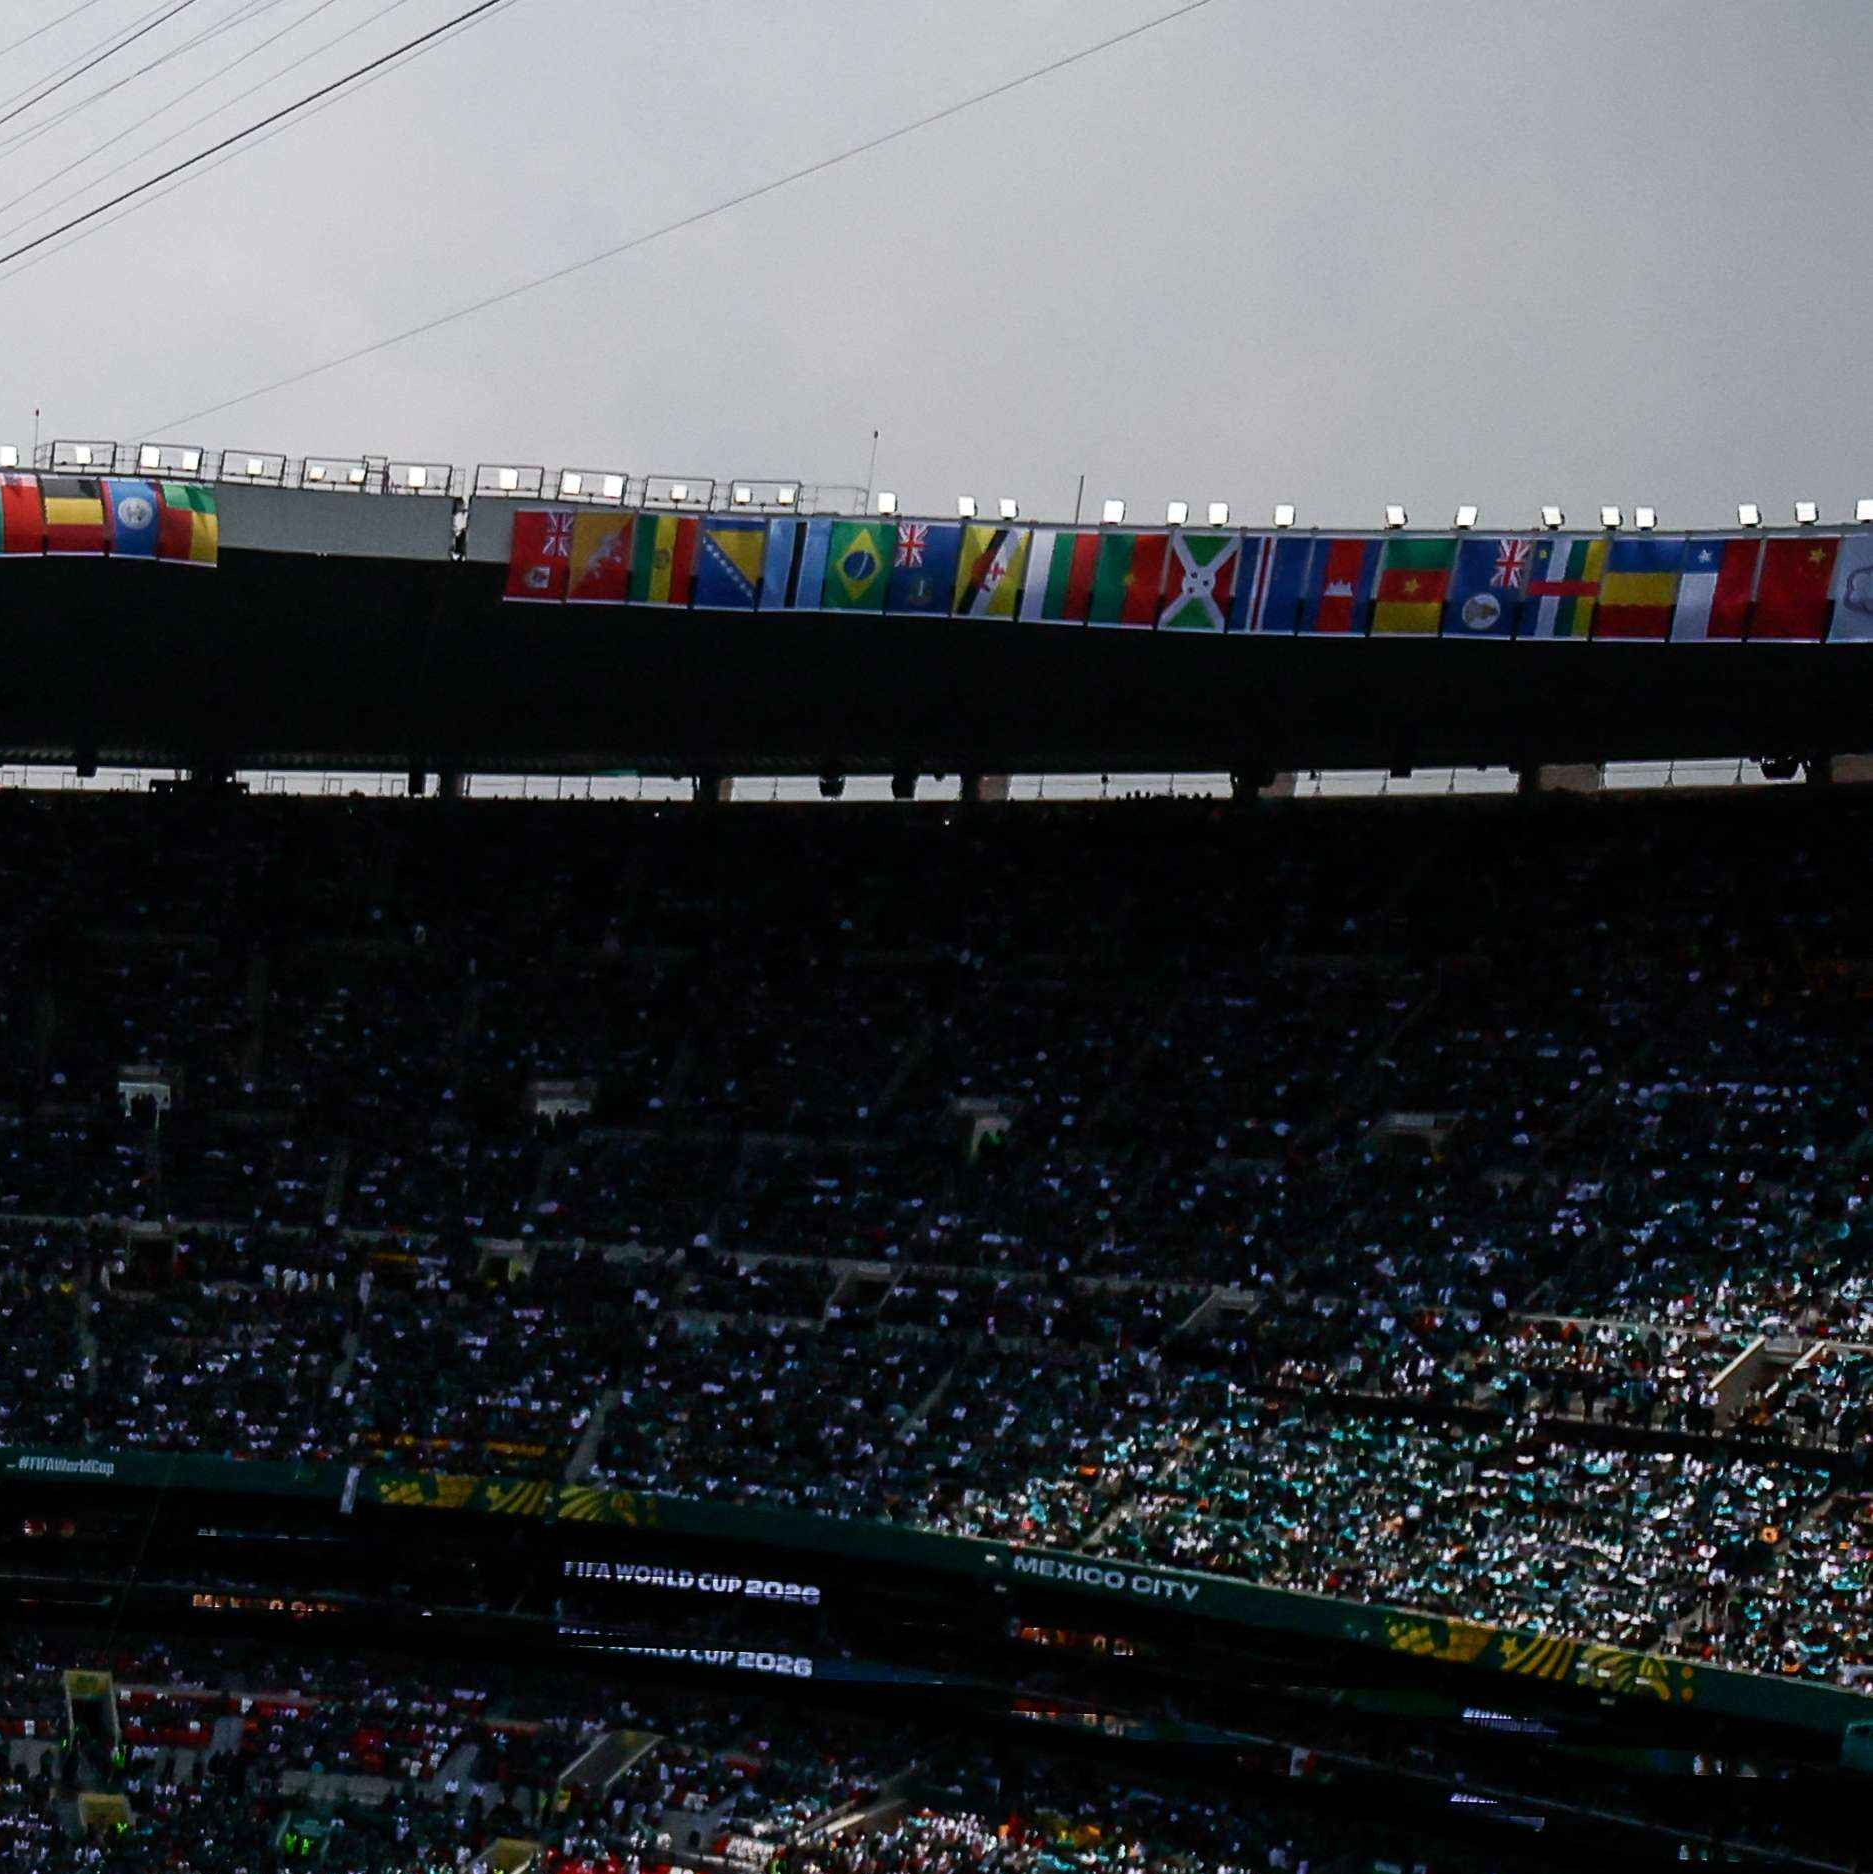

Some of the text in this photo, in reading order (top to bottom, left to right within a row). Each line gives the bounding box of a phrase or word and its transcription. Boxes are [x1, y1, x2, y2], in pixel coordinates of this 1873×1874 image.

[615, 1563, 695, 1588] WORLD
[698, 1572, 743, 1594] CUP
[1013, 1555, 1200, 1602] MEXICO CITY
